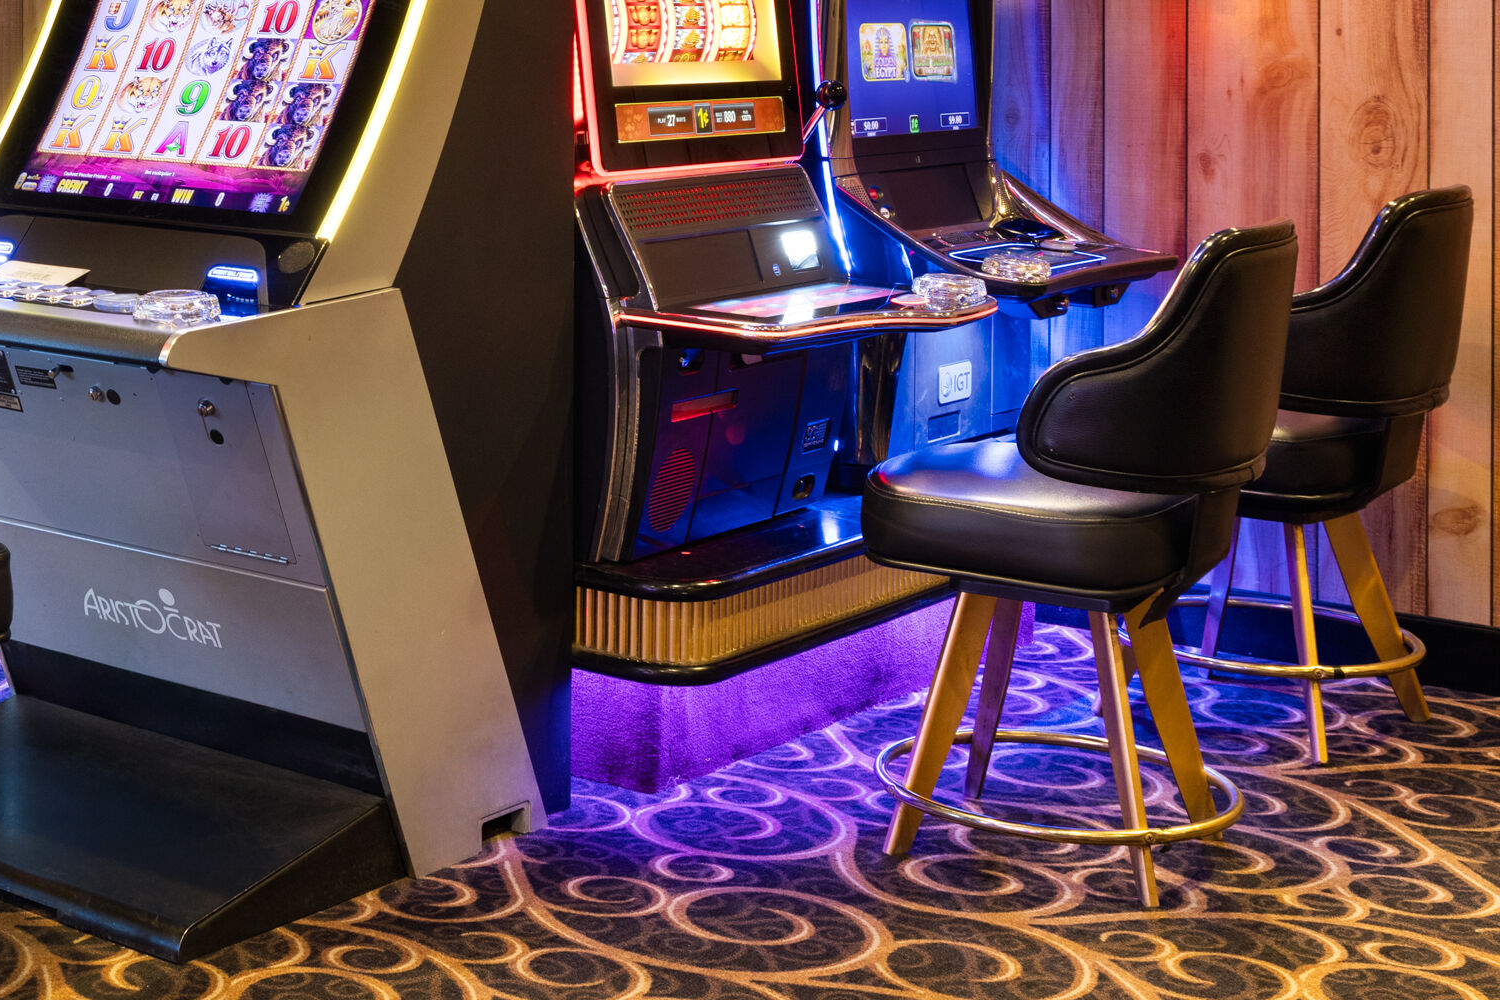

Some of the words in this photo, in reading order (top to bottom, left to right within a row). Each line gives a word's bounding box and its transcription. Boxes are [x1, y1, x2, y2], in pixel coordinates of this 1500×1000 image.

[84, 35, 129, 72] K
[135, 37, 176, 73] 10
[297, 42, 348, 82] K
[875, 56, 897, 68] GOLDEN
[875, 67, 897, 78] EGYPT
[71, 75, 102, 110] Q
[176, 80, 211, 116] 9
[49, 115, 96, 149] K
[100, 118, 147, 153] K
[667, 114, 676, 127] 27
[152, 121, 189, 157] A
[205, 124, 252, 160] 10
[56, 178, 89, 194] CREDIT
[104, 182, 114, 197] 0
[132, 190, 145, 200] BET
[171, 188, 195, 204] WIN
[215, 192, 226, 207] 0
[954, 371, 970, 393] IGT
[84, 588, 222, 649] ARISTOCRAT
